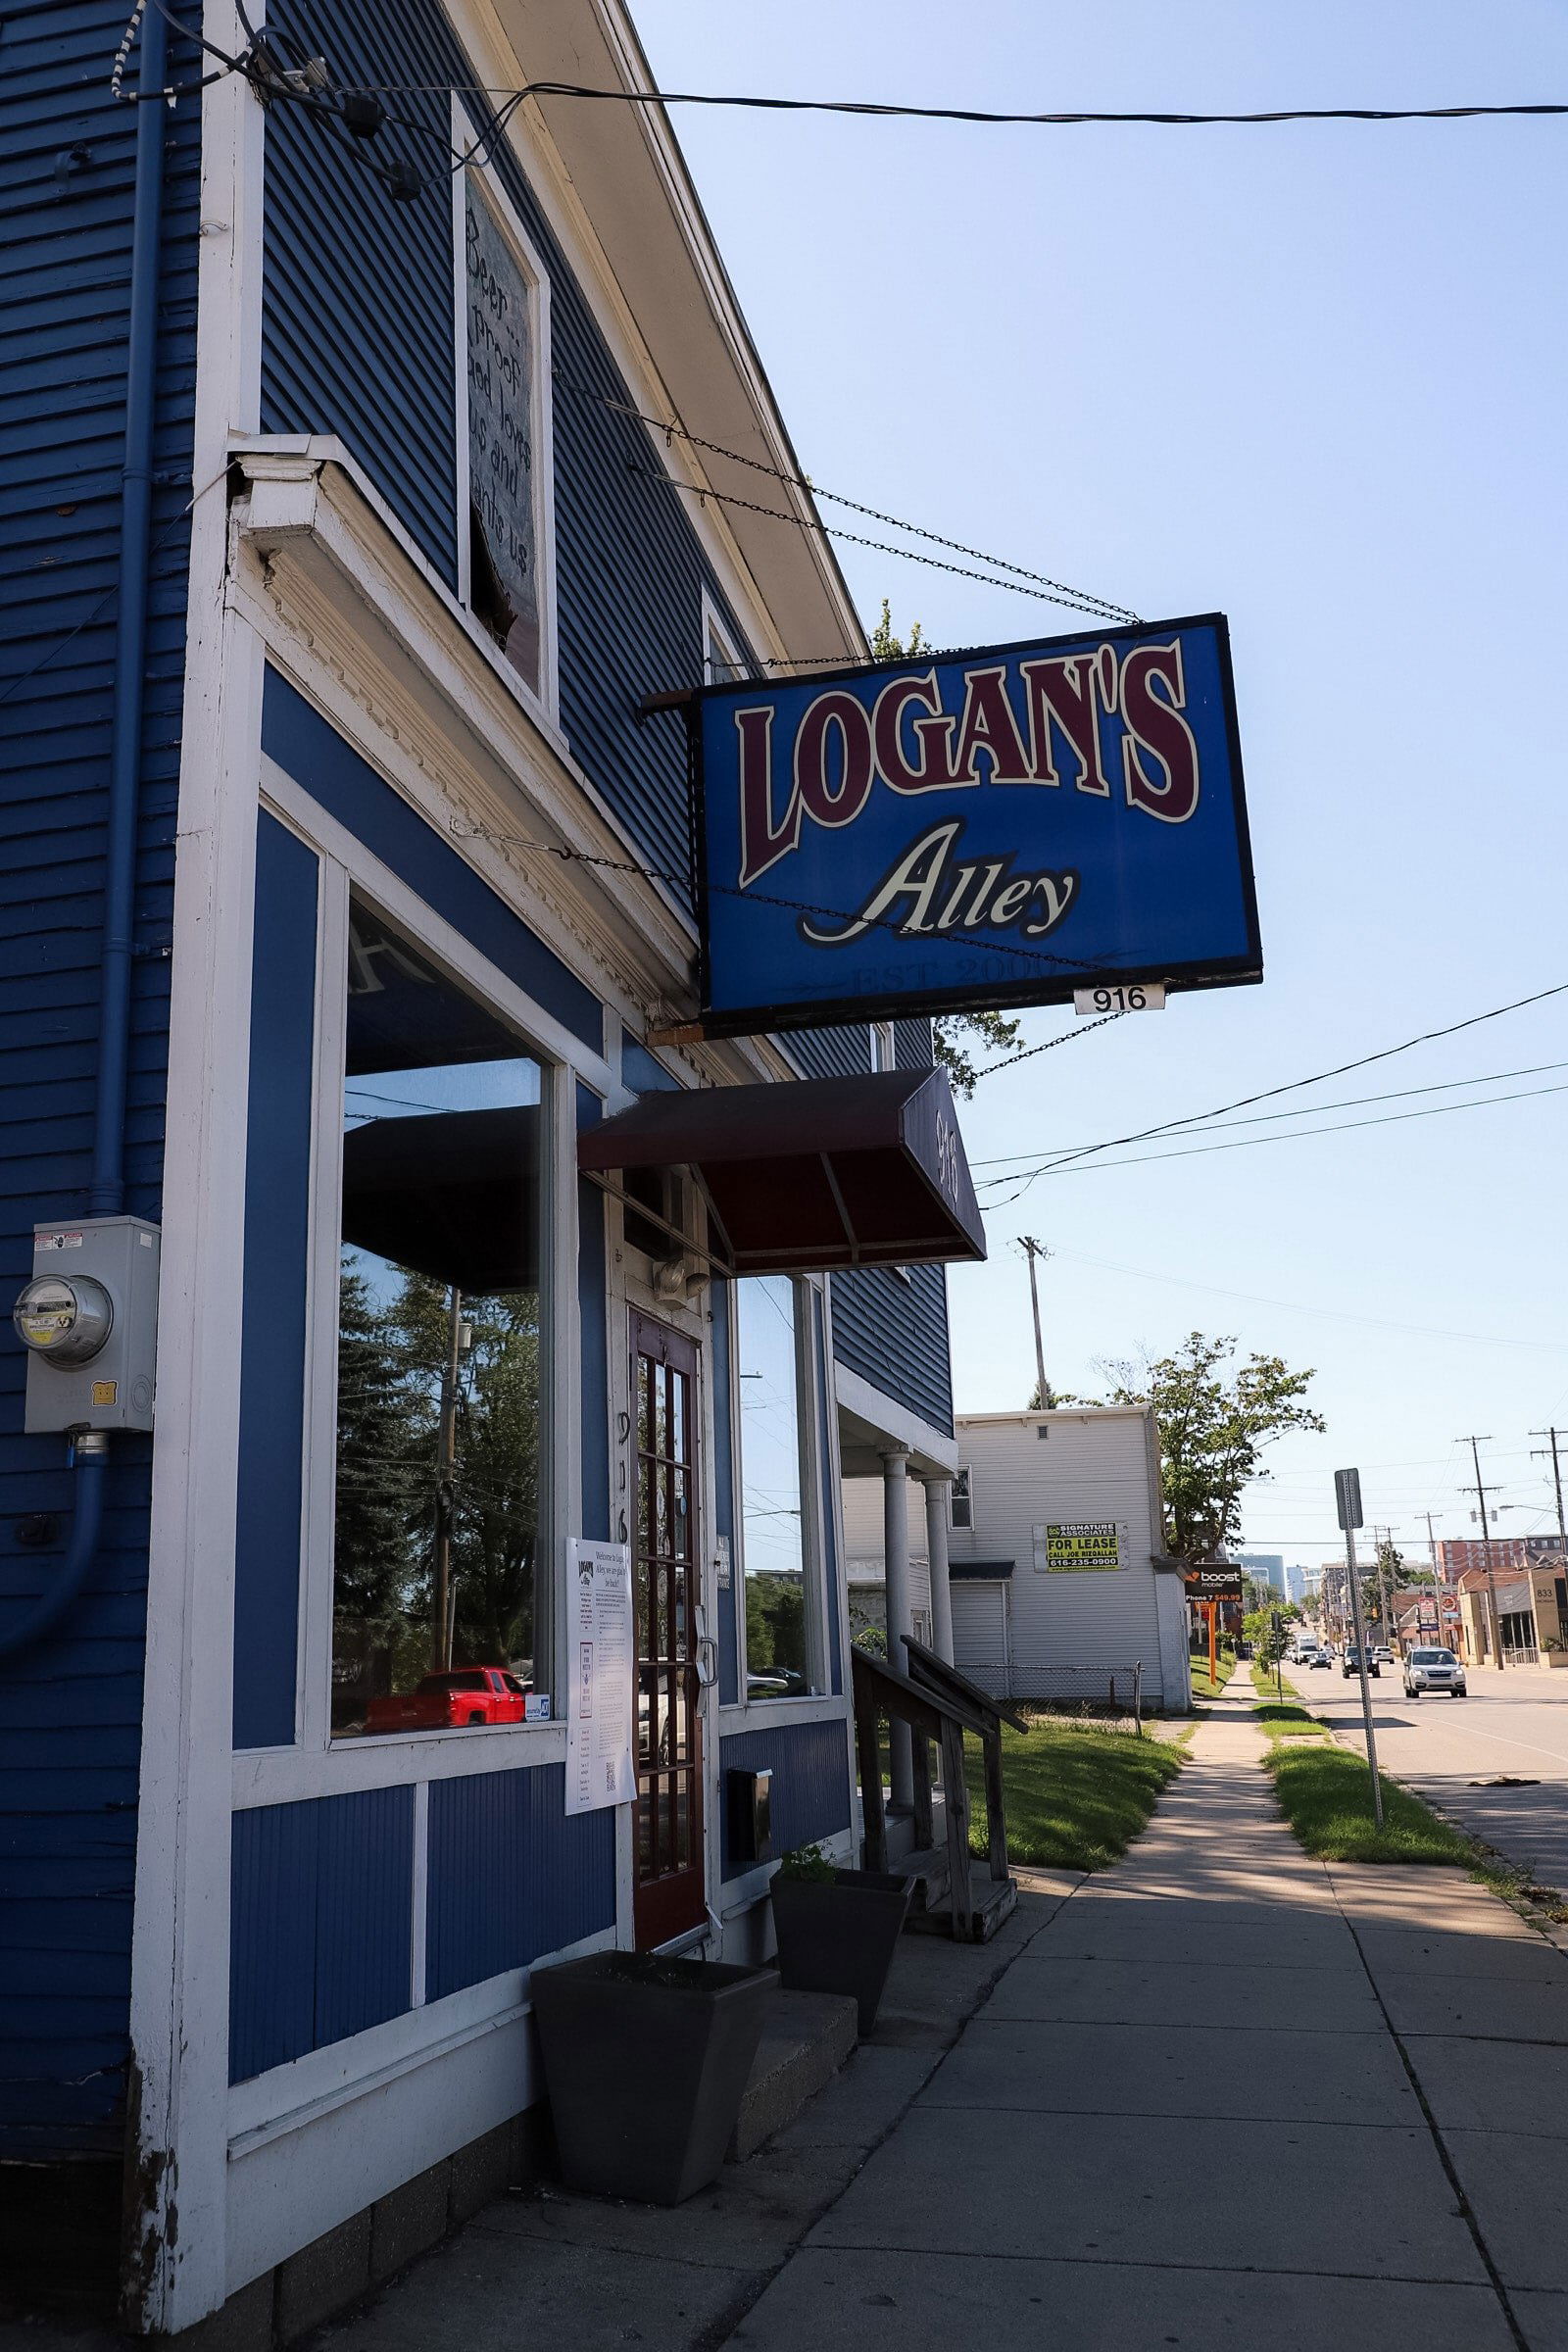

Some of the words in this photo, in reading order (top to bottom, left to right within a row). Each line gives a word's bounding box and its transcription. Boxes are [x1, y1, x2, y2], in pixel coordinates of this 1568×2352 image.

[491, 439, 518, 508] and
[510, 525, 527, 576] us
[735, 637, 1199, 890] LOGAN'S
[802, 822, 1074, 942] Alley
[1093, 986, 1147, 1013] 916
[936, 1108, 958, 1204] 916
[1049, 1540, 1072, 1550] FOR
[1078, 1539, 1116, 1549] LEASE
[1201, 1572, 1240, 1582] boost
[1537, 1589, 1552, 1597] 833
